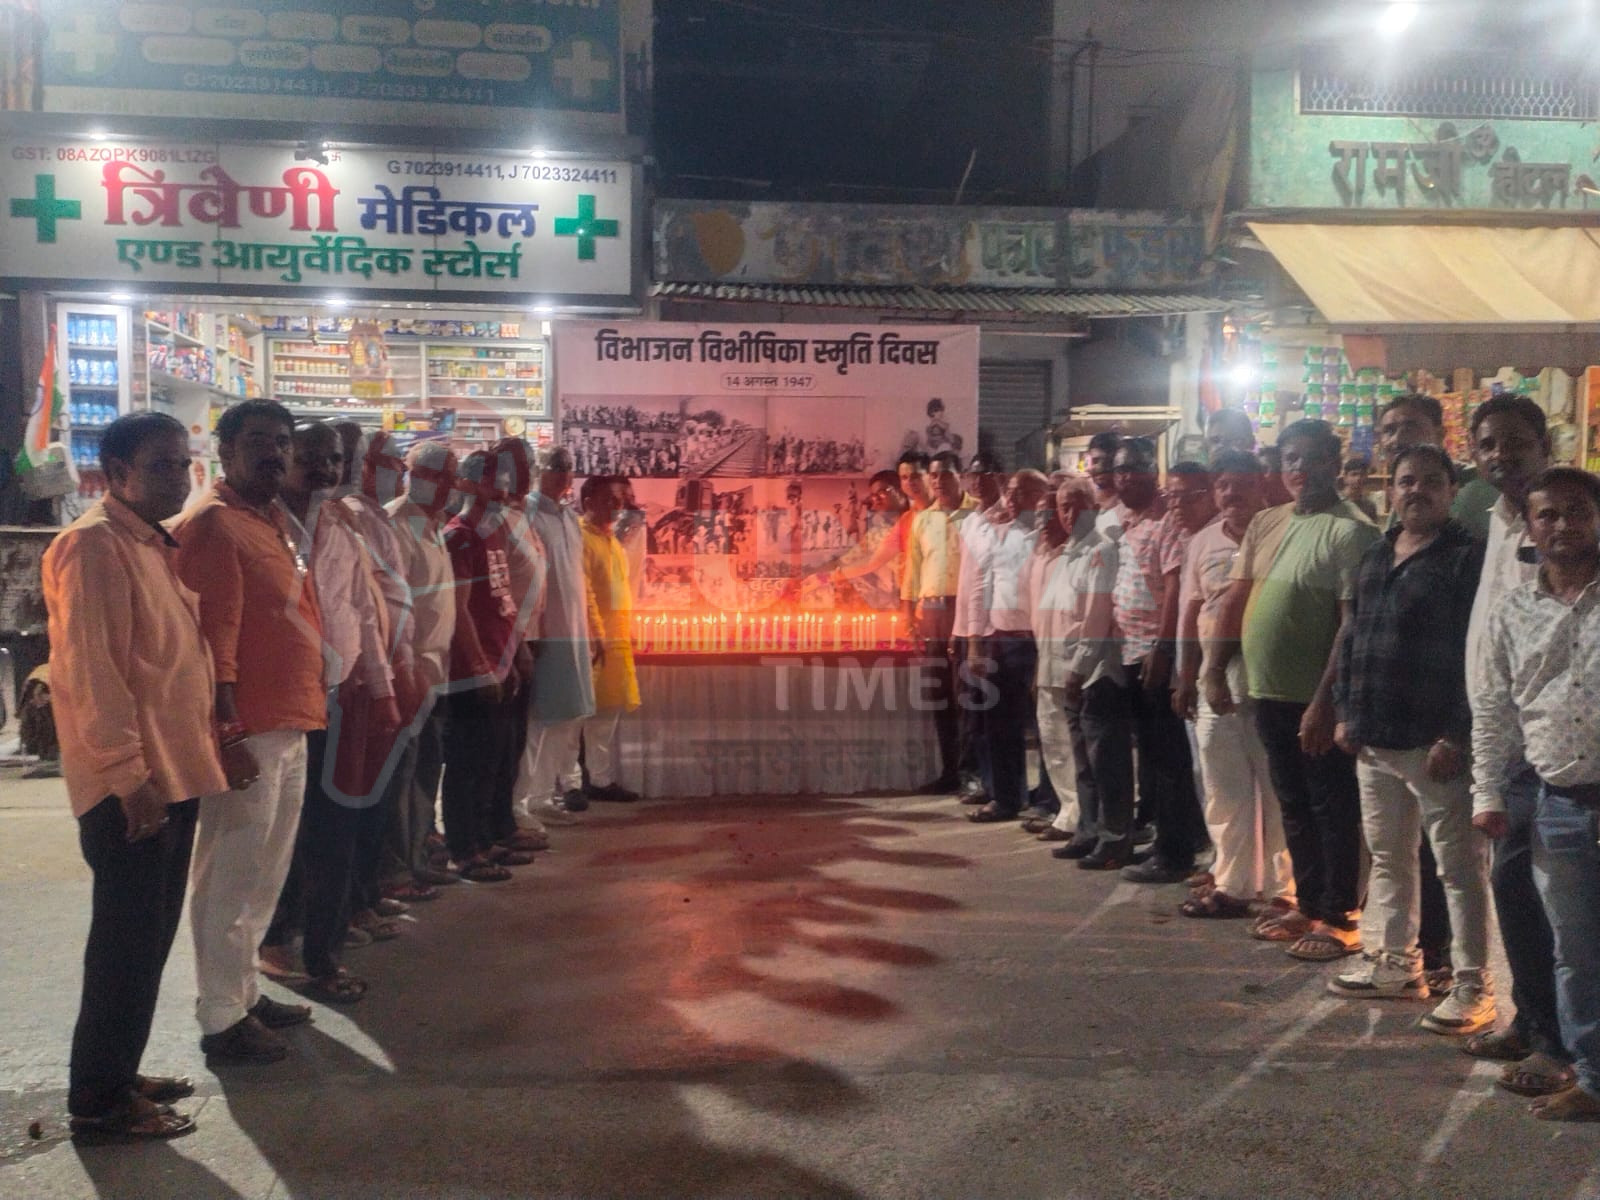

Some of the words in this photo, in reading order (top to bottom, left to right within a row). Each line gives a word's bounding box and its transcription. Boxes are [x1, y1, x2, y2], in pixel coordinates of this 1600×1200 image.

[12, 147, 50, 160] GST:
[523, 165, 617, 183] 7023324411
[102, 160, 341, 232] त्रिवेणी
[357, 184, 539, 238] मेडिकल
[116, 238, 203, 272] एण्ड
[212, 235, 414, 282] आयुर्वेदिक
[422, 240, 522, 278] स्टोर्स
[596, 328, 694, 362] विभाजन
[698, 331, 807, 363] विभीषिका
[812, 332, 874, 376] स्मृति
[878, 333, 939, 364] दिवस
[726, 376, 740, 386] 14
[744, 376, 778, 387] अगस्त
[783, 376, 812, 387] 1947
